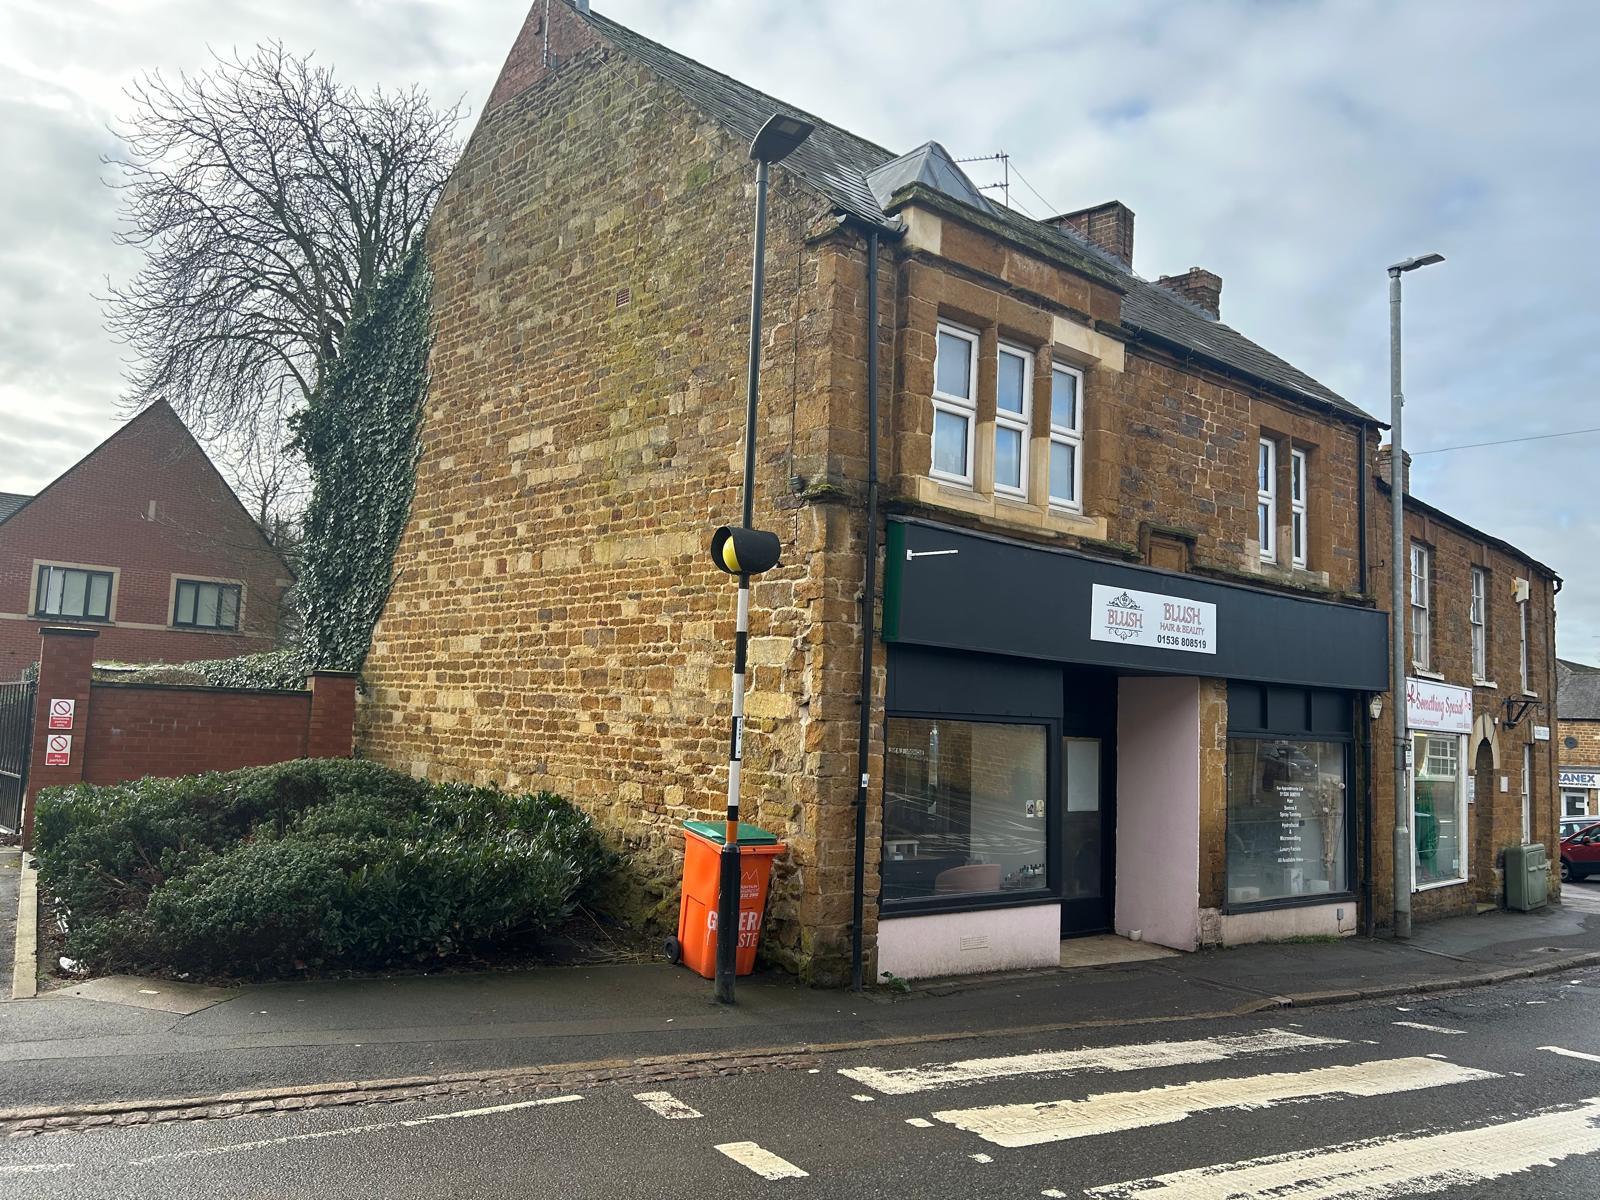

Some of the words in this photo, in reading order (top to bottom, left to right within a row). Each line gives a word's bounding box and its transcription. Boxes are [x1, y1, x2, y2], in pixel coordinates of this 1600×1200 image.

[1107, 609, 1143, 628] BLUSH
[1163, 602, 1201, 625] BLUSH
[1160, 622, 1176, 632] HAIR
[1176, 624, 1181, 633] &
[1182, 625, 1204, 636] BEAUTY
[1157, 635, 1180, 646] 01536
[1181, 637, 1207, 649] 808519
[1416, 691, 1444, 720] Something
[1446, 696, 1463, 718] Special
